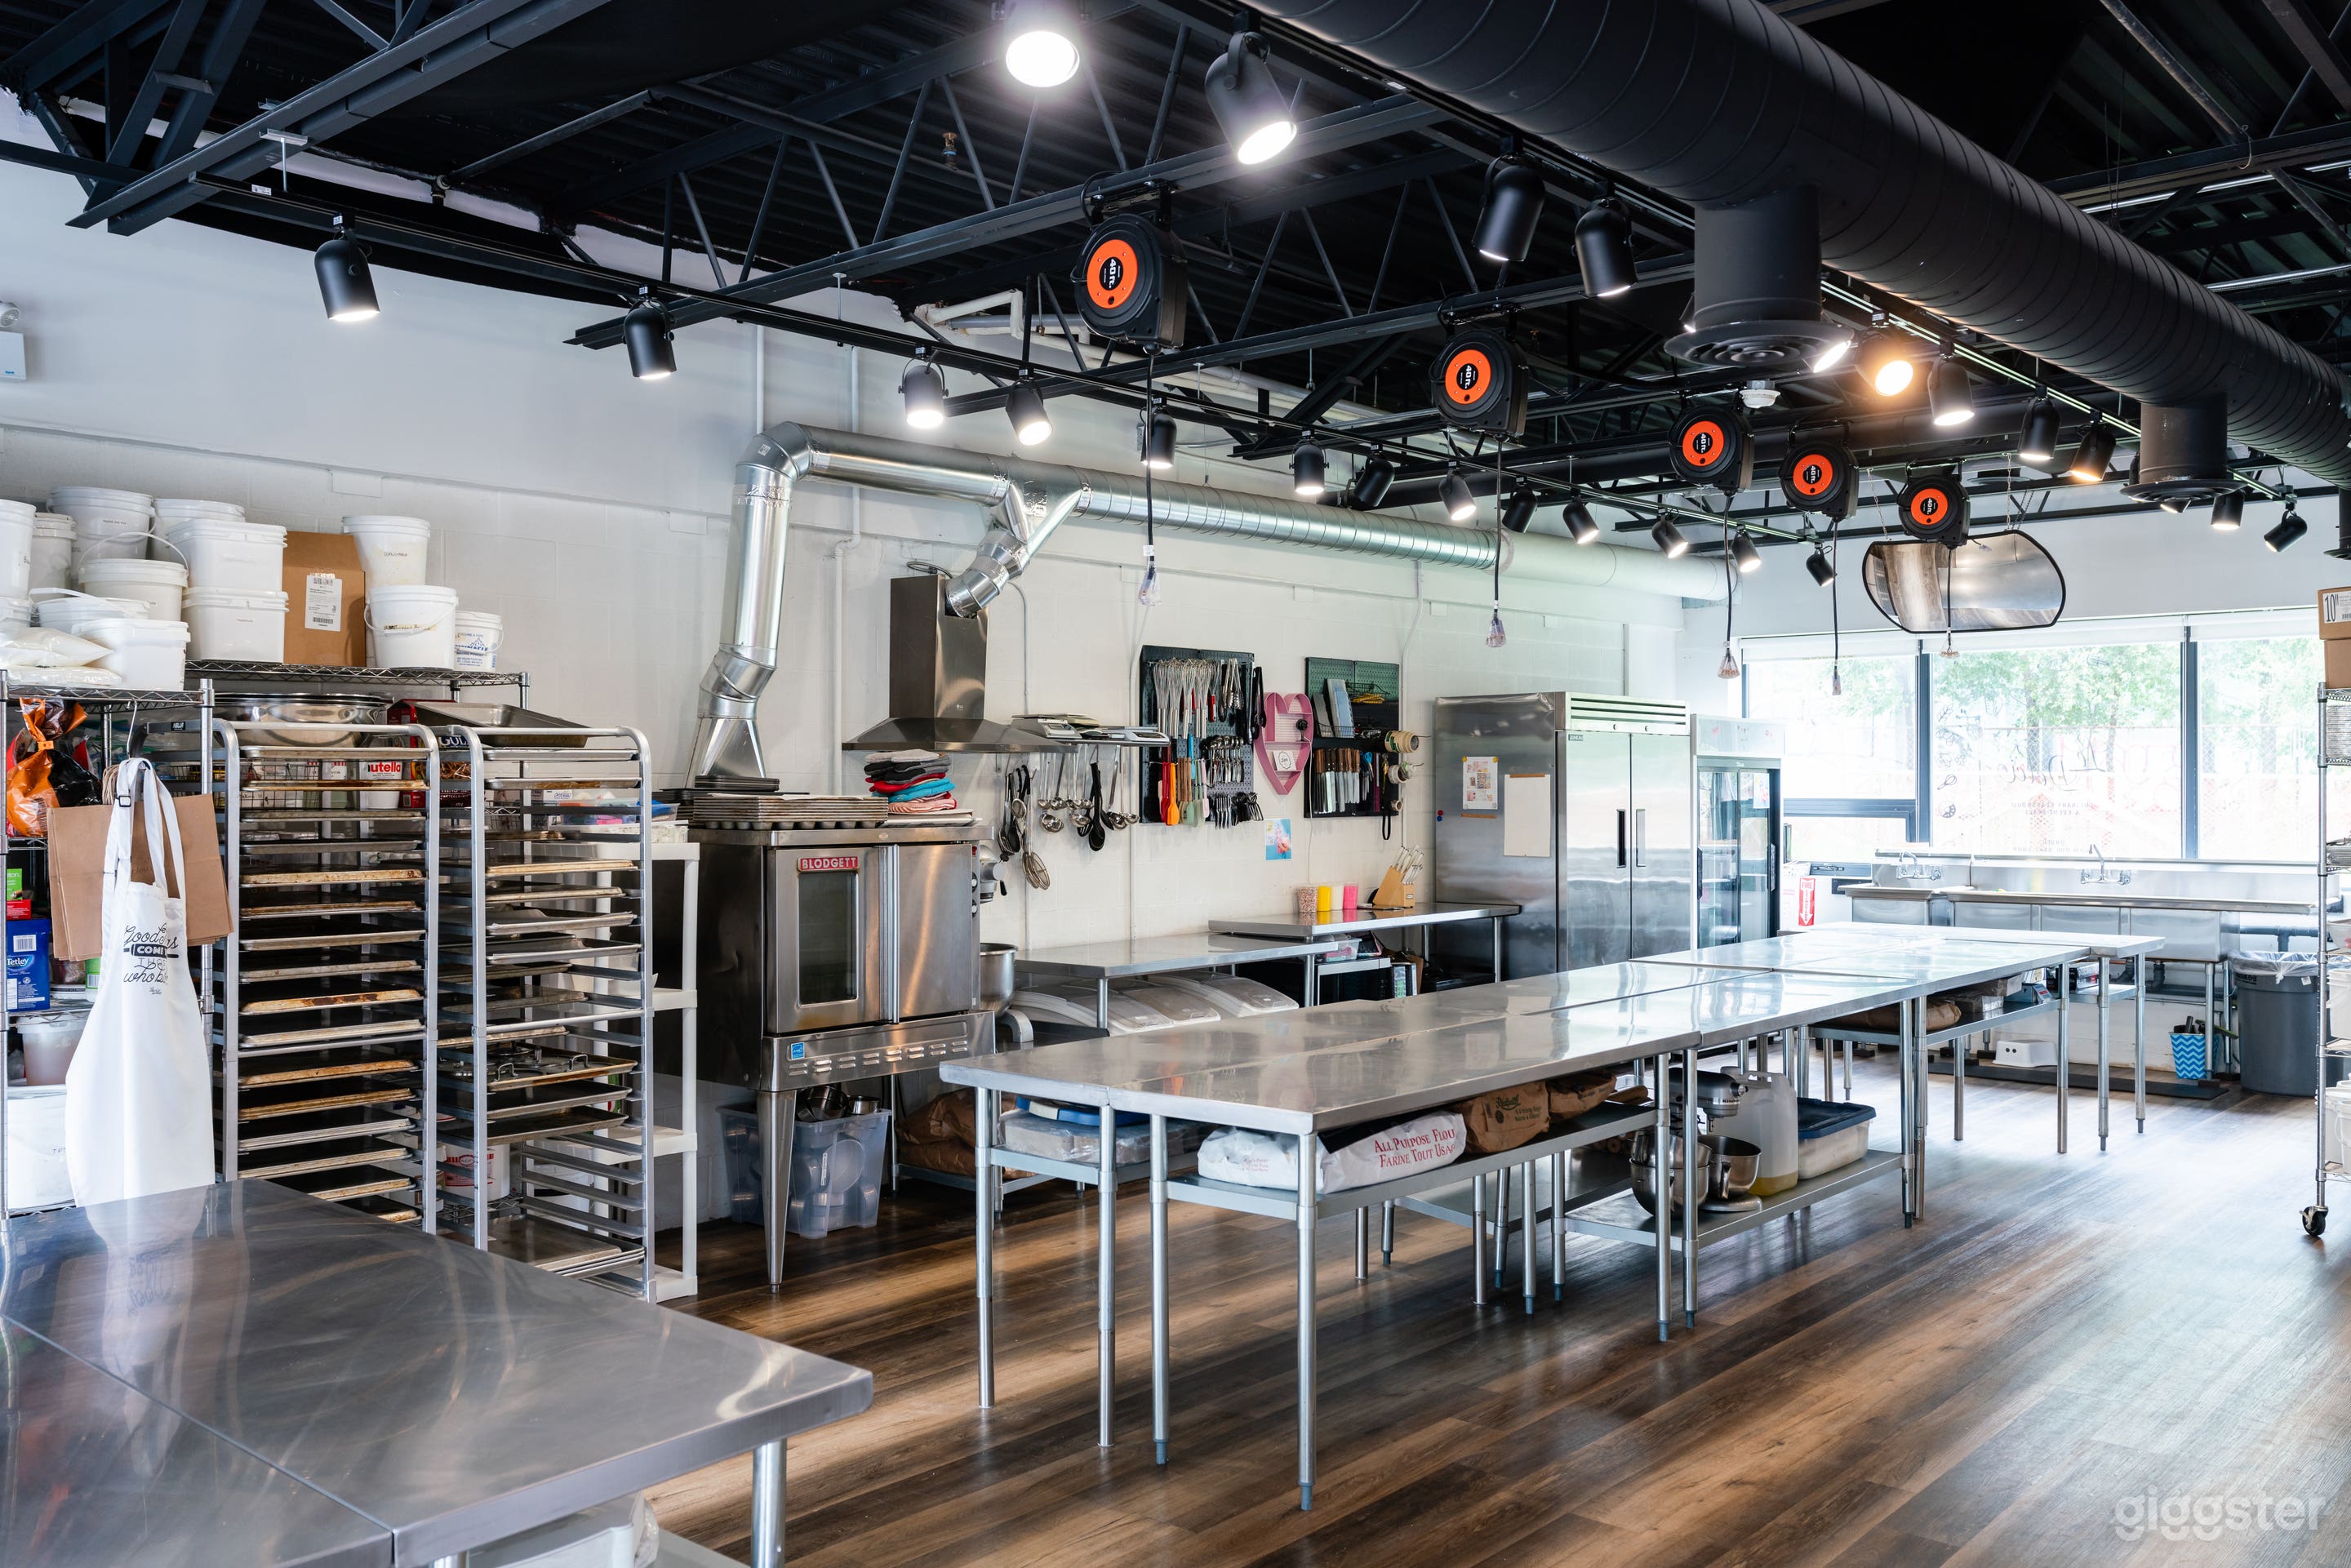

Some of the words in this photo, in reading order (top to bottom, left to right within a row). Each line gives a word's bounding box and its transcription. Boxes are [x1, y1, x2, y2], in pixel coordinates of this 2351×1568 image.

[1109, 259, 1117, 275] 40
[1465, 365, 1472, 378] 40
[438, 736, 469, 747] GUL
[802, 857, 856, 869] BLODGETT
[7, 958, 29, 966] Tetley
[1374, 1139, 1393, 1153] ALL
[1431, 1129, 1456, 1142] FLOU
[1380, 1153, 1411, 1168] FARINE
[1410, 1148, 1433, 1162] TOUT
